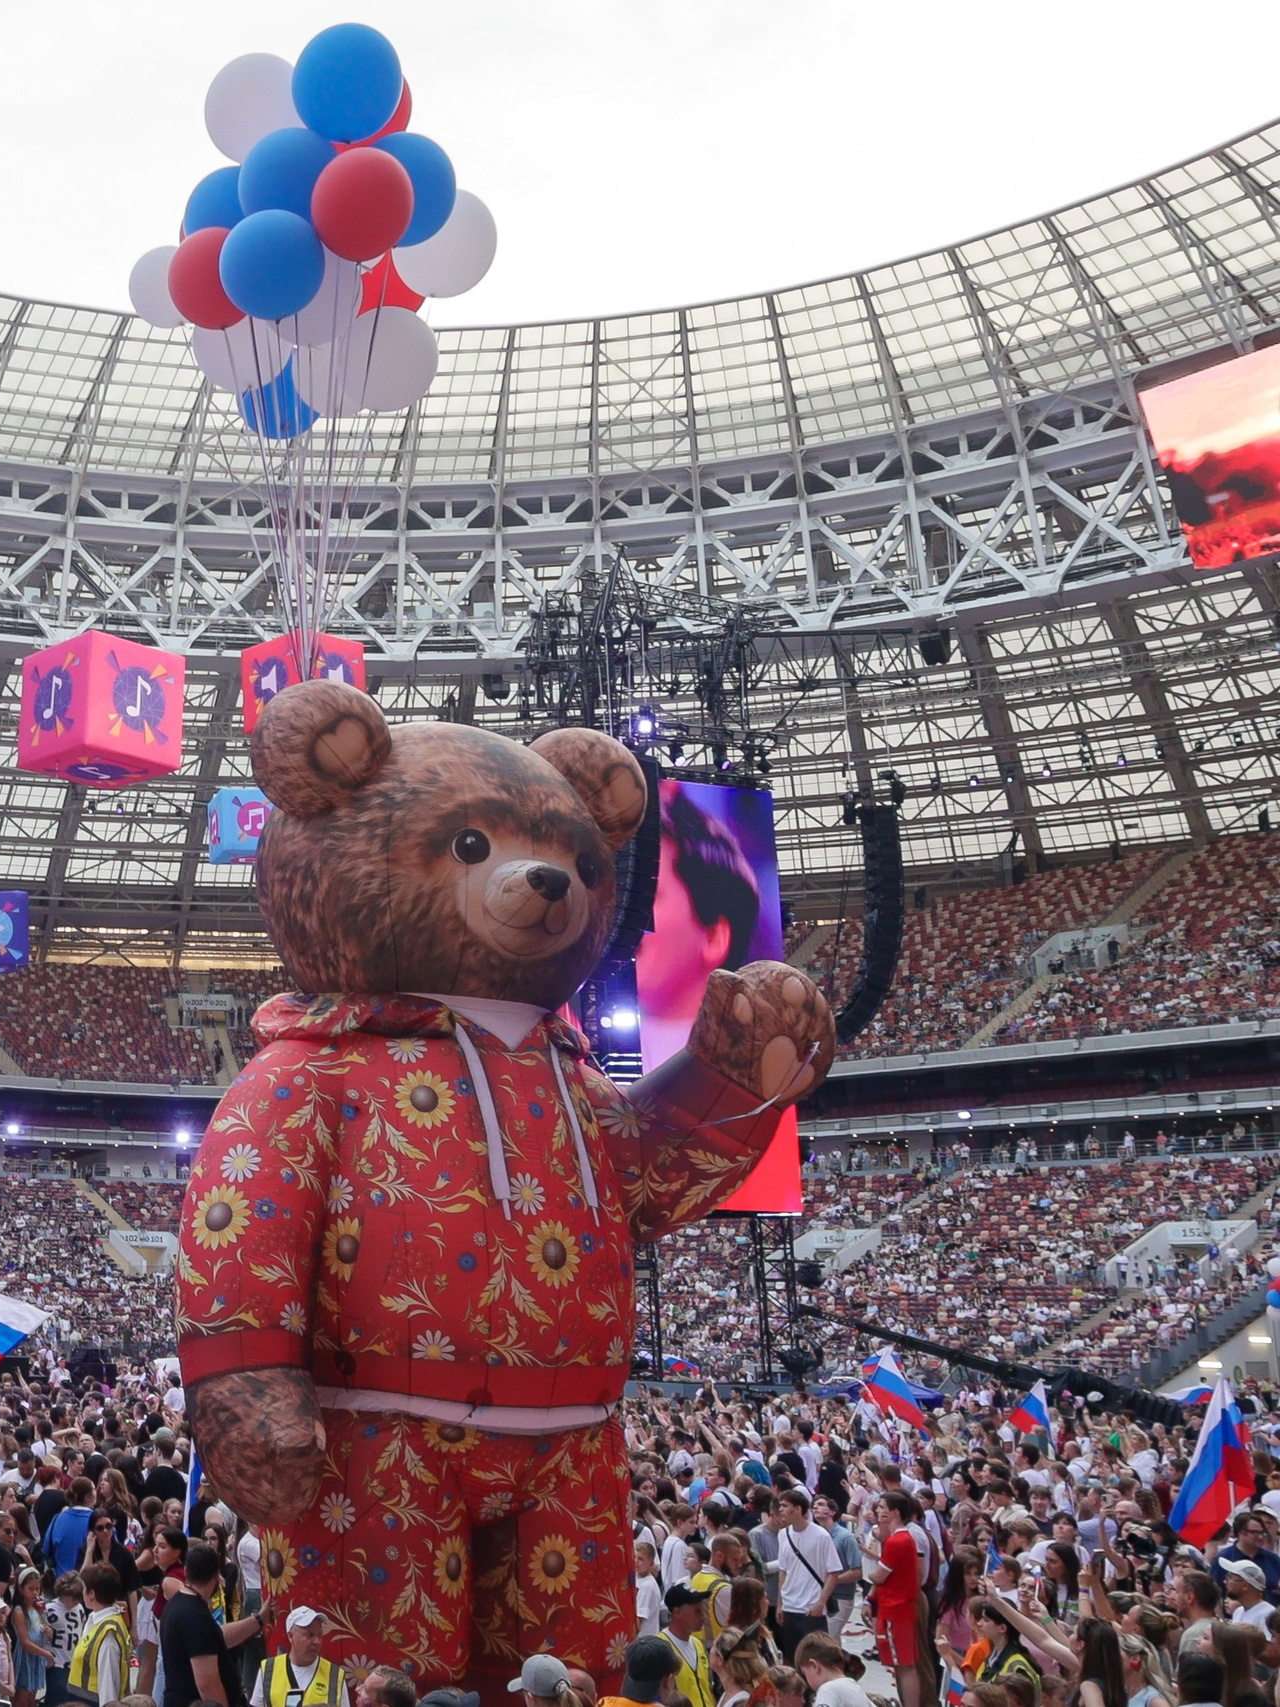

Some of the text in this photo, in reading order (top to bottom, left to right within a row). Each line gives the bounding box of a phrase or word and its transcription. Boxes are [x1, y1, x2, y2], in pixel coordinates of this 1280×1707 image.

[1182, 1228, 1201, 1238] 152
[125, 1234, 138, 1242] 102
[151, 1235, 164, 1243] 101
